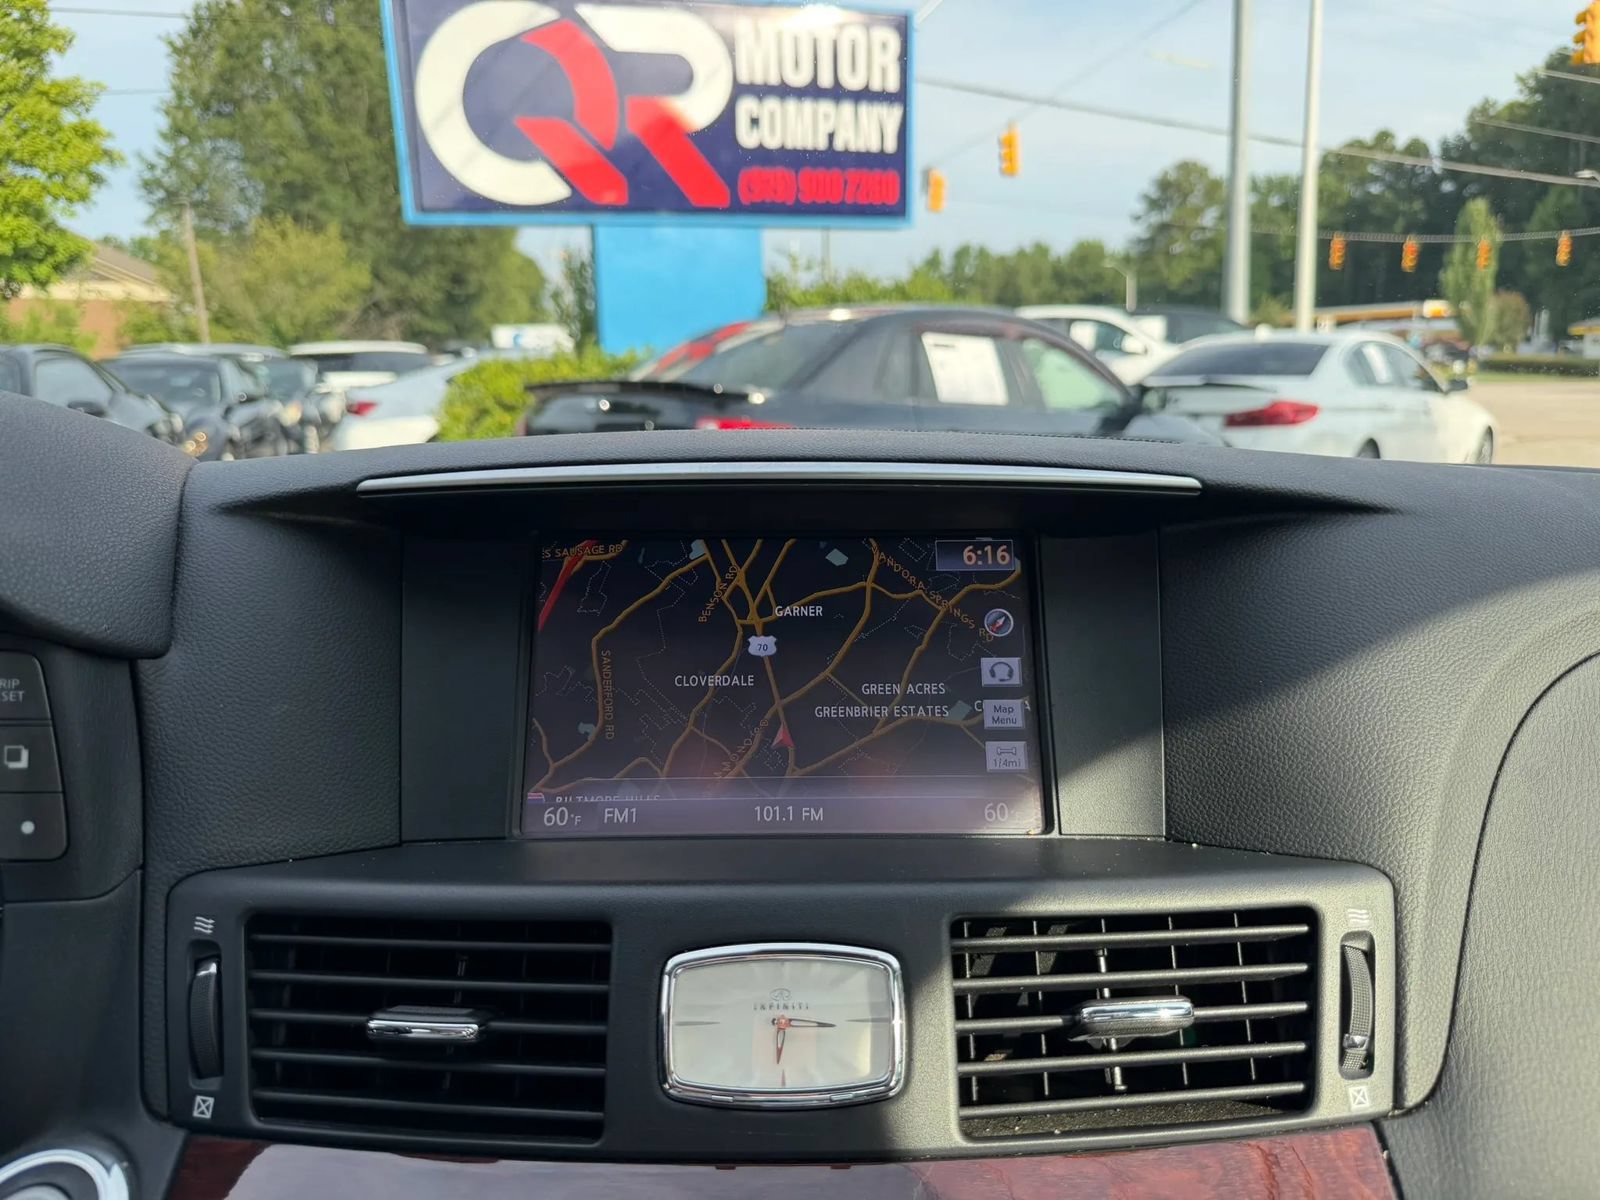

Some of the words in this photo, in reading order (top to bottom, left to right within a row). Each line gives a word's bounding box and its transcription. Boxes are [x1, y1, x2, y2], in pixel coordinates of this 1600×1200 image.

[735, 17, 901, 93] MOTOR
[735, 95, 904, 154] COMPANY
[555, 544, 605, 557] SAUSAGE
[608, 543, 624, 553] RD
[963, 545, 1011, 566] 6:16
[698, 582, 728, 622] BENSON
[725, 564, 739, 583] RD
[871, 546, 926, 591] VANDORA
[929, 590, 976, 629] SPRINGS
[979, 627, 994, 642] RD
[775, 606, 823, 617] GARNER
[757, 643, 769, 652] 70
[602, 650, 614, 721] SANDERFORD
[674, 675, 755, 686] CLOVERDALE
[861, 684, 900, 695] GREEN
[906, 683, 946, 694] ACRES
[815, 706, 889, 718] GREENBRIER
[894, 705, 949, 717] ESTATES
[993, 705, 1014, 716] Map
[992, 716, 1017, 725] Menu
[605, 724, 615, 740] RD
[604, 808, 637, 823] FM1
[754, 806, 793, 821] 101.1
[802, 808, 824, 821] FM
[753, 1002, 809, 1011] INFINITI
